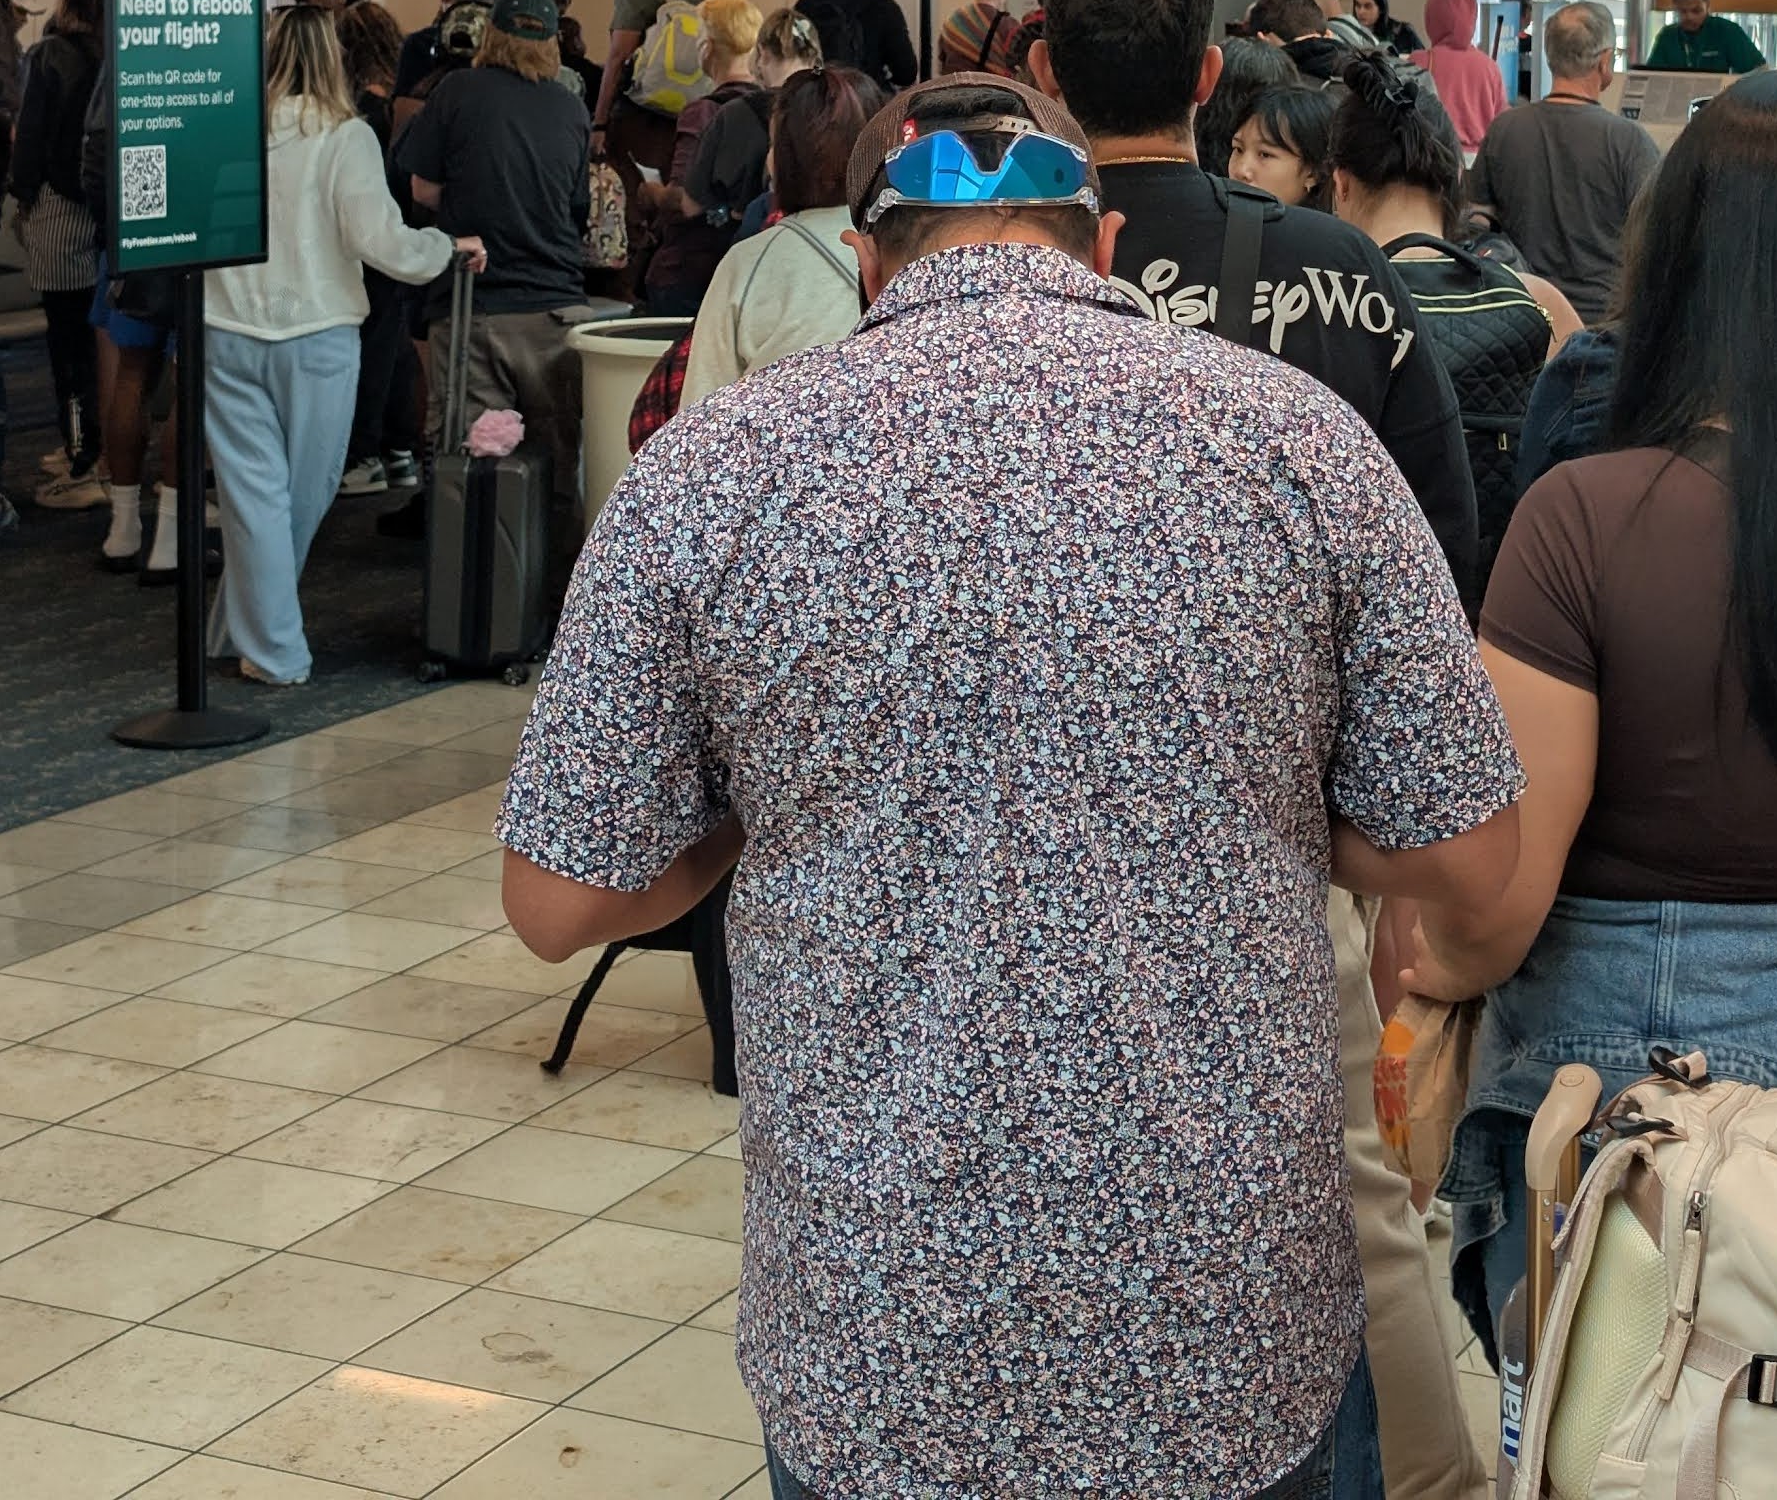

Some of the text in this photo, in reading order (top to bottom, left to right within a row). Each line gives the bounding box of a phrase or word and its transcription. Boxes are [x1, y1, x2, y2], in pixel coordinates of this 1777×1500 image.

[120, 21, 220, 50] your flight?
[120, 68, 222, 87] Scan the QR code for
[120, 89, 234, 109] one-stop access to all of
[120, 115, 184, 134] your options.
[1107, 258, 1310, 355] isey
